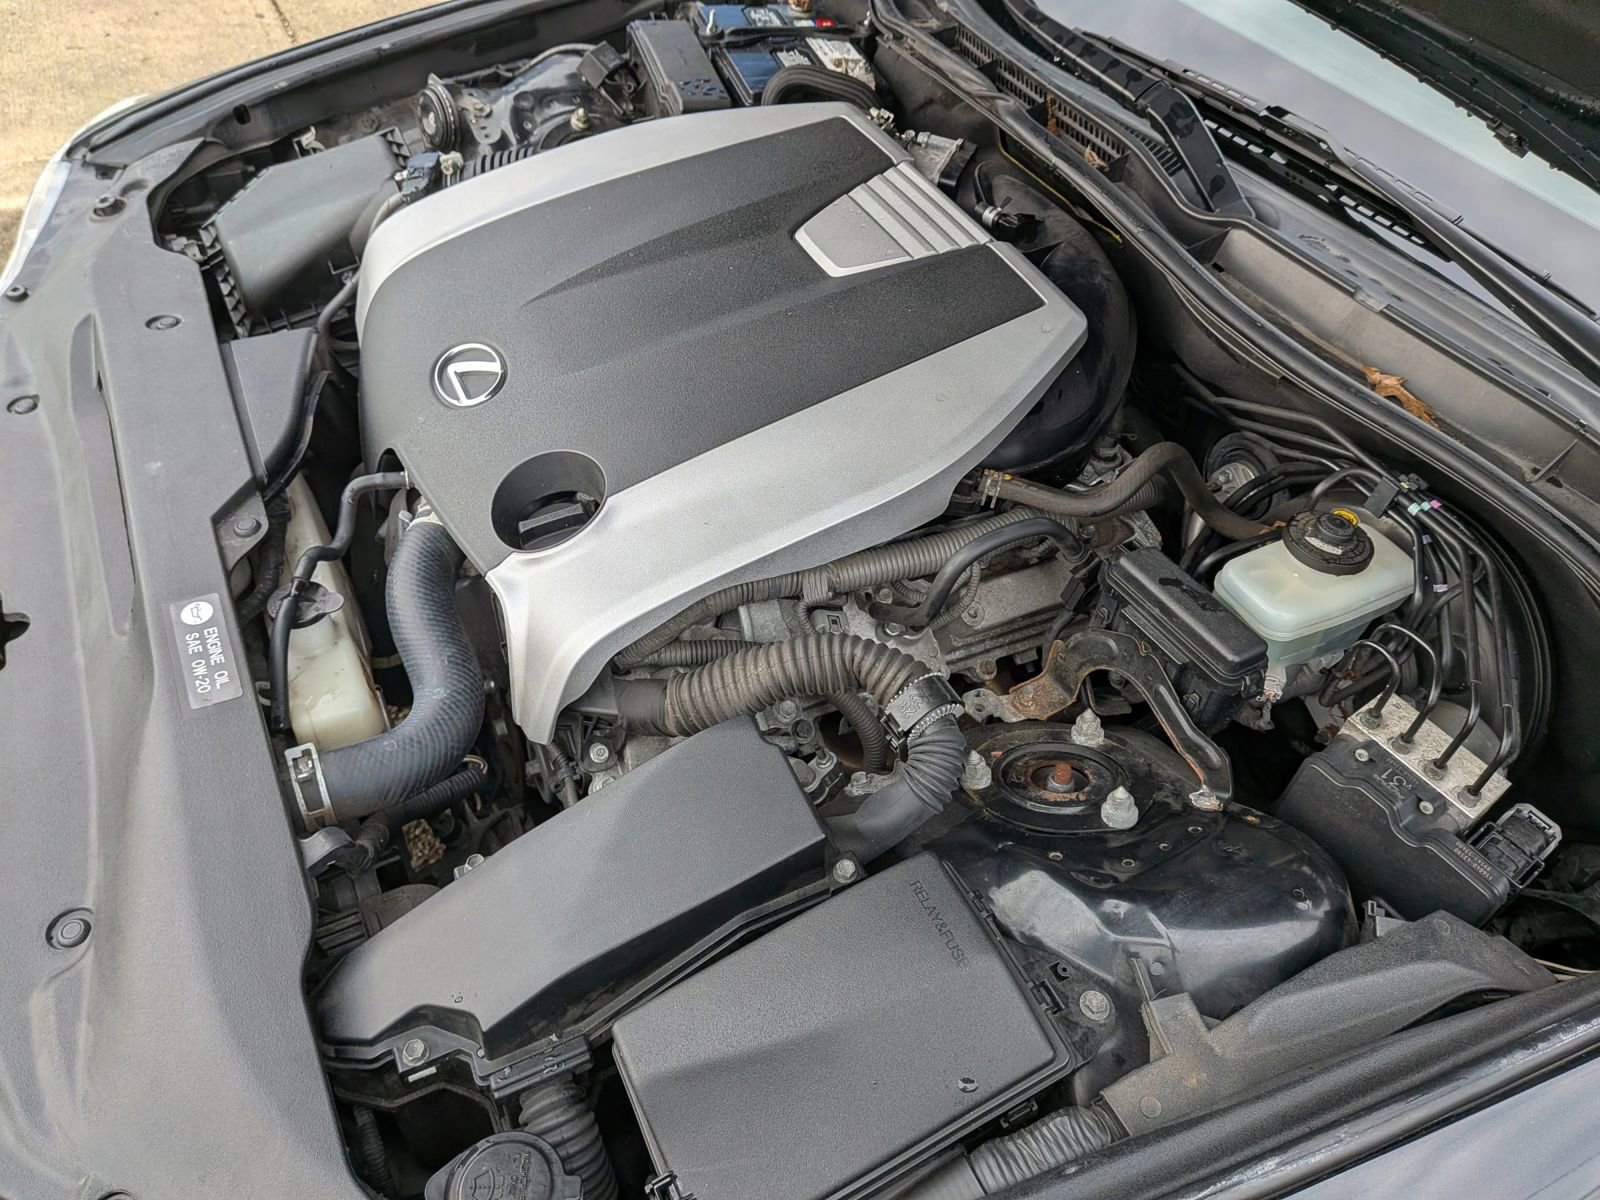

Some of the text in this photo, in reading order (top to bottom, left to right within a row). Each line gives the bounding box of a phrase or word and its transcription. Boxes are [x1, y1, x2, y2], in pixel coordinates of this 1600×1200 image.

[185, 632, 212, 694] SAE 0W-20
[203, 626, 230, 690] ENGINE OIL
[910, 880, 970, 971] RELAY&FUSE
